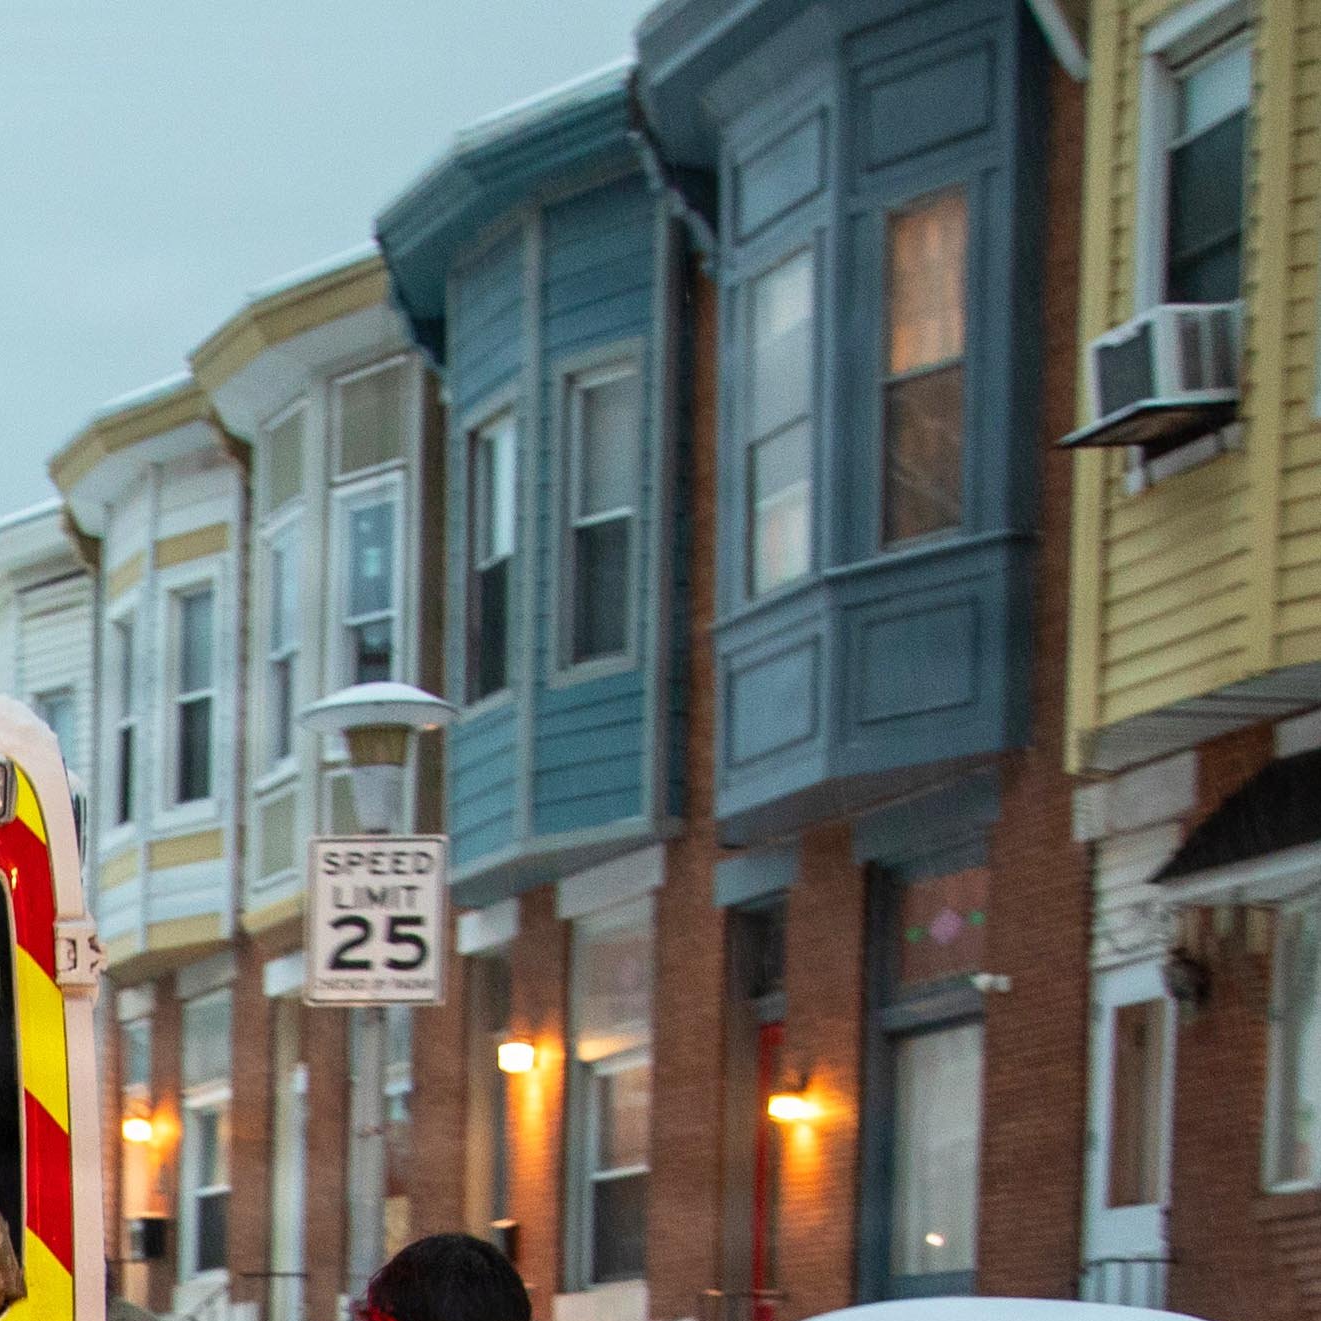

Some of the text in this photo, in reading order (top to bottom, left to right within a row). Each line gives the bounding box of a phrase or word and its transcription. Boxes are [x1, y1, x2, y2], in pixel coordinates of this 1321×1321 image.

[323, 851, 433, 876] SPEED
[332, 884, 421, 911] LIMIT
[328, 914, 429, 971] 25
